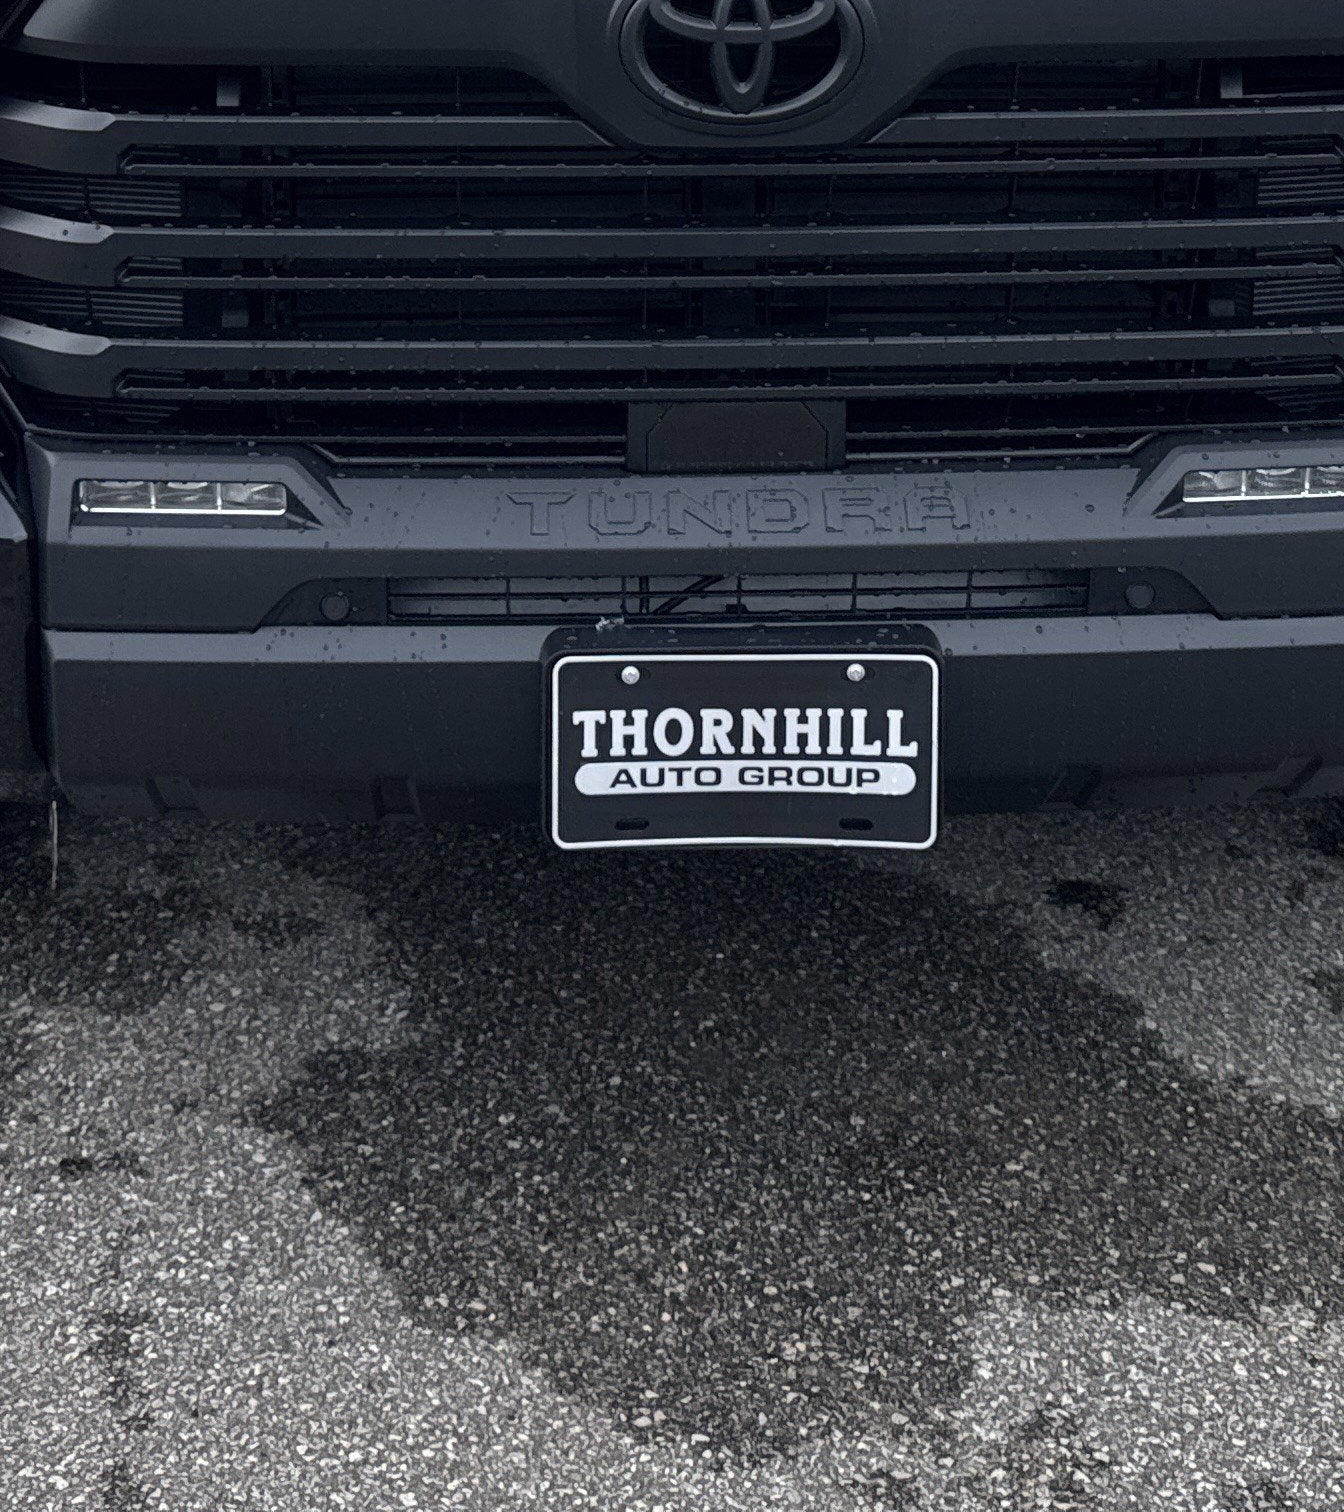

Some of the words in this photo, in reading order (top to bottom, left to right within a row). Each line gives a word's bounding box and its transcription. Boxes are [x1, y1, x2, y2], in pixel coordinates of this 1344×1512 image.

[506, 487, 972, 536] TUNDRA
[572, 707, 919, 758] THORNHILL
[609, 766, 723, 789] AUTO
[737, 766, 881, 788] GROUP
